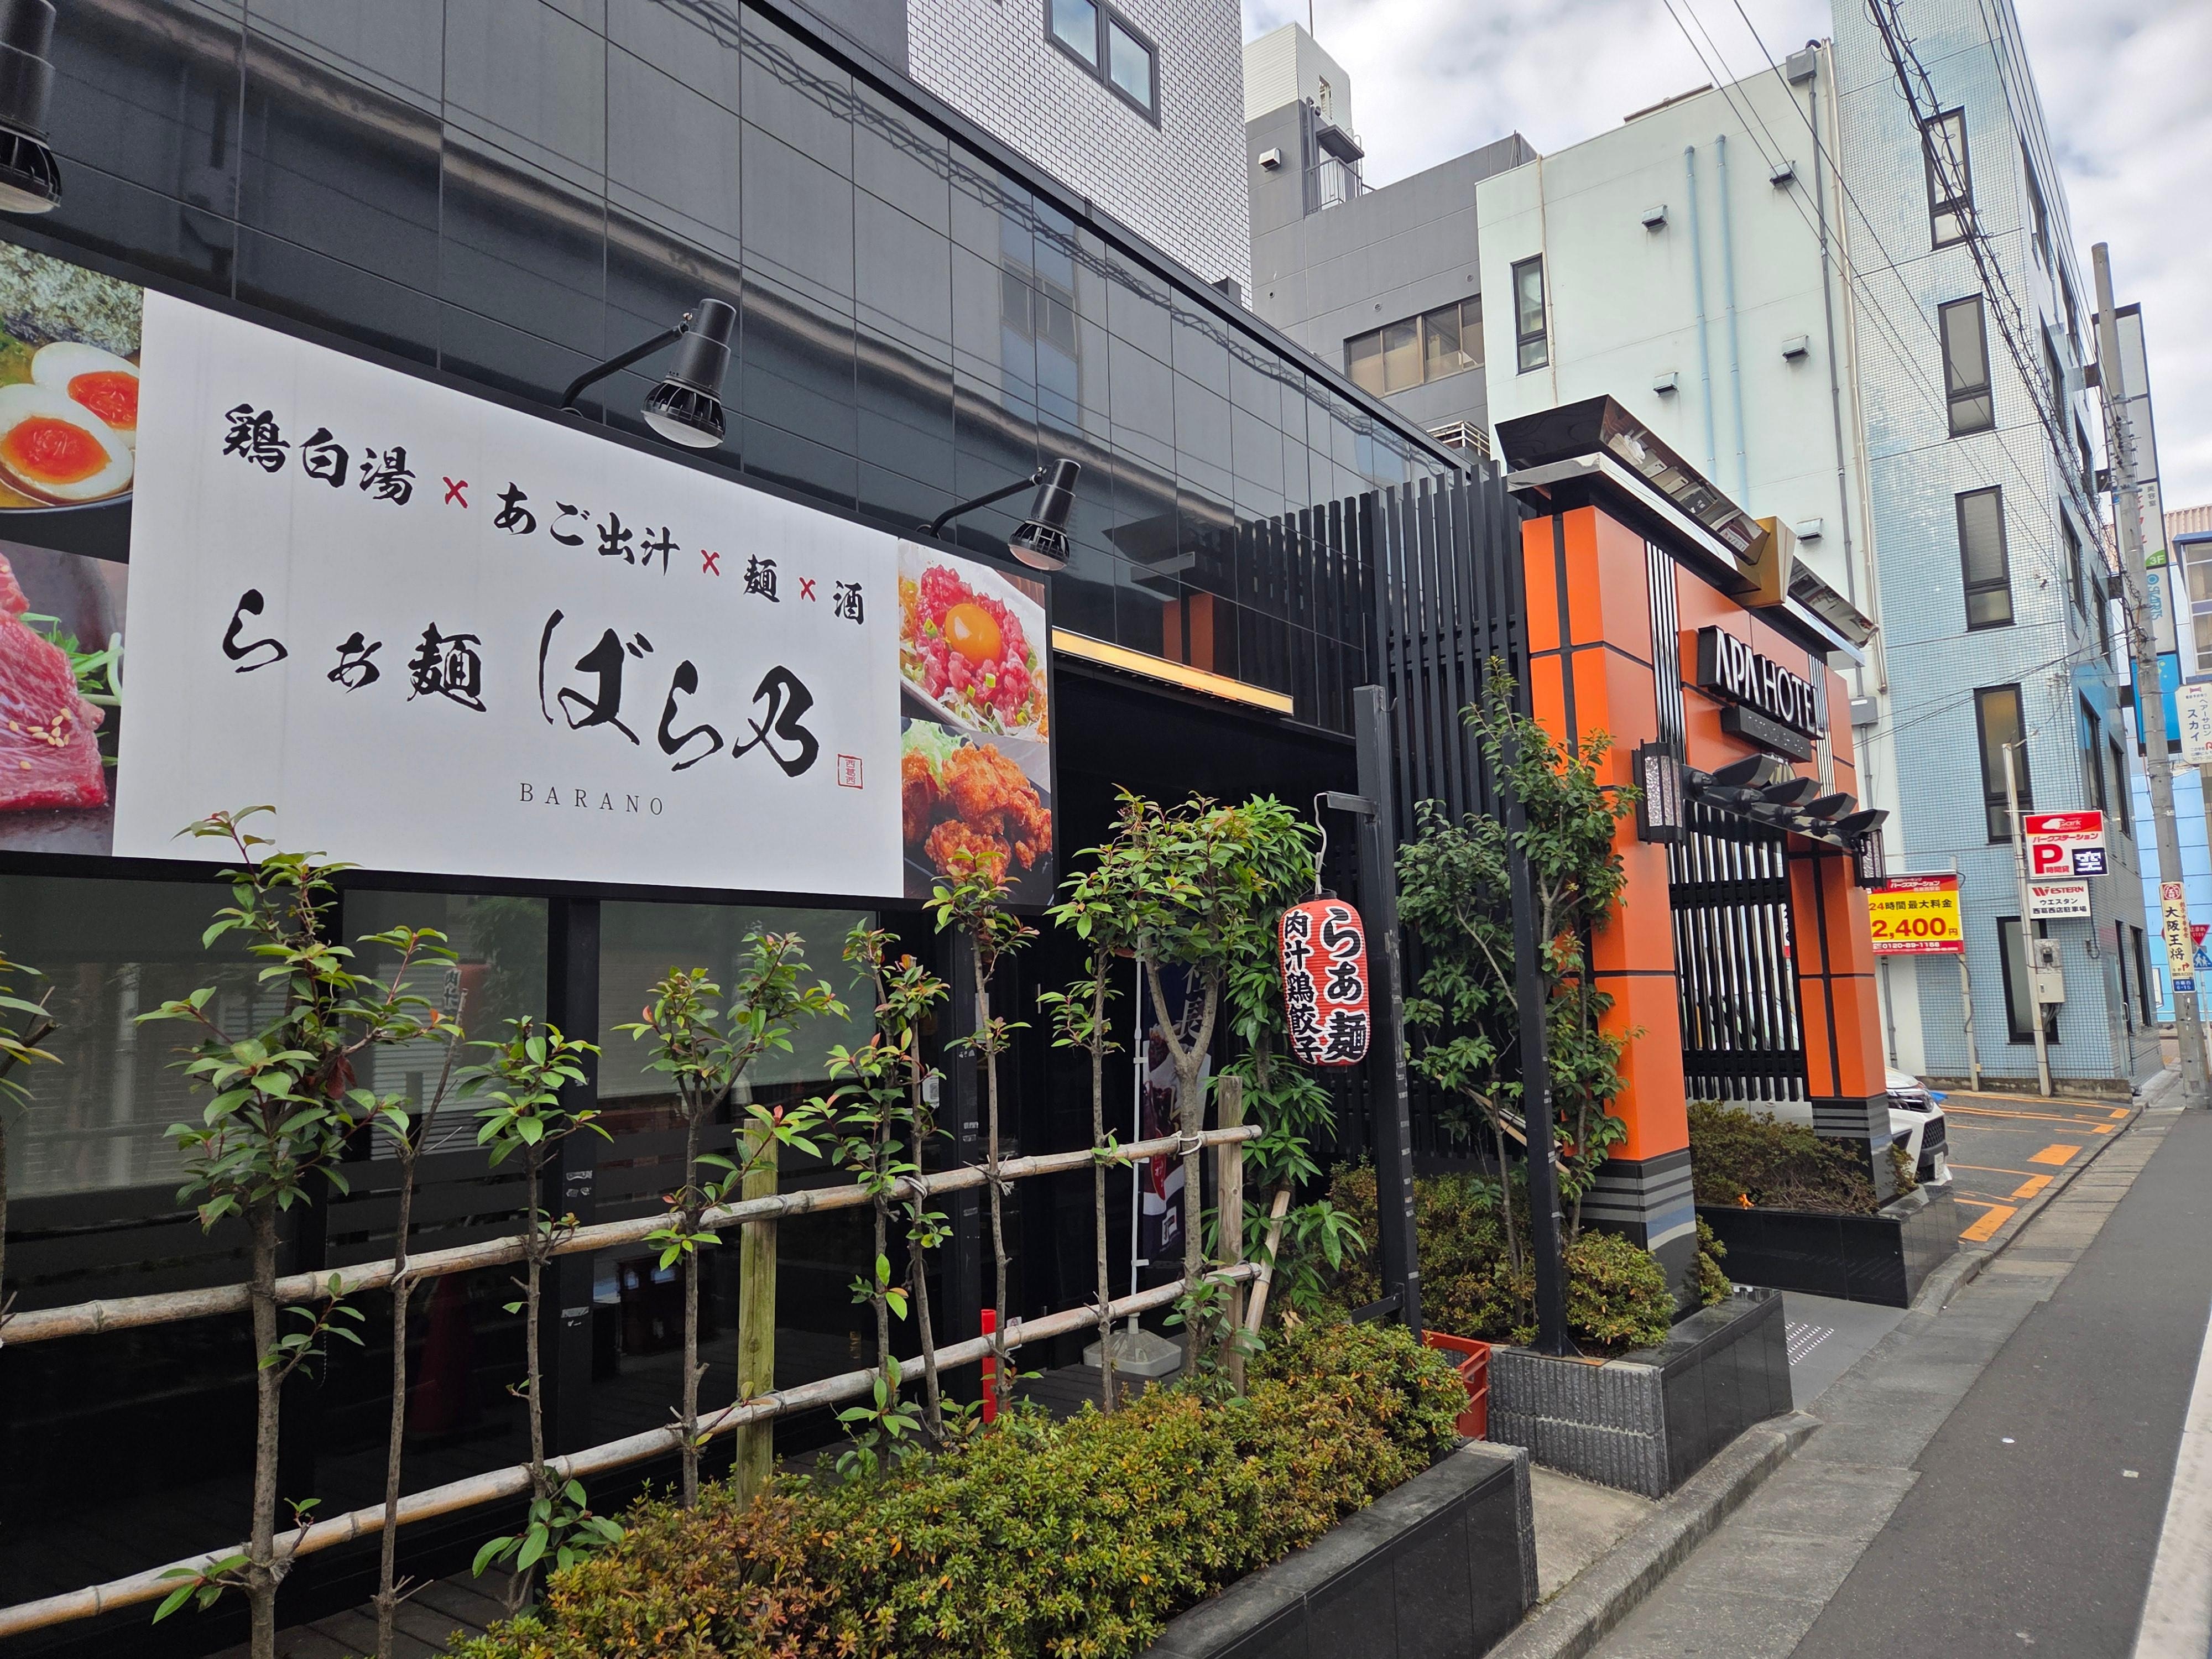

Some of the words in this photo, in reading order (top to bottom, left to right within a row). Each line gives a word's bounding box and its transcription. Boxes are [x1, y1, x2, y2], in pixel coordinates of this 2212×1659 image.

[222, 403, 416, 506] 鶏白湯
[493, 482, 681, 576] あご出汁
[832, 580, 864, 624] 酒
[2150, 555, 2165, 565] 3F
[1715, 627, 1764, 707] APA
[1761, 656, 1824, 738] HOTEL
[2188, 708, 2199, 742] スカイ
[2199, 698, 2211, 736] ヘアーサロン
[845, 759, 856, 785] 西葛西
[520, 783, 663, 815] BARANO
[2032, 833, 2099, 843] パークステーション
[2033, 844, 2063, 874] P
[2074, 851, 2103, 872] 空
[2032, 886, 2084, 896] WESTERN
[2032, 906, 2087, 914] 西葛西店駐車場
[2164, 906, 2185, 961] 大阪王将
[1284, 910, 1323, 1063] 肉汁鶏餃子
